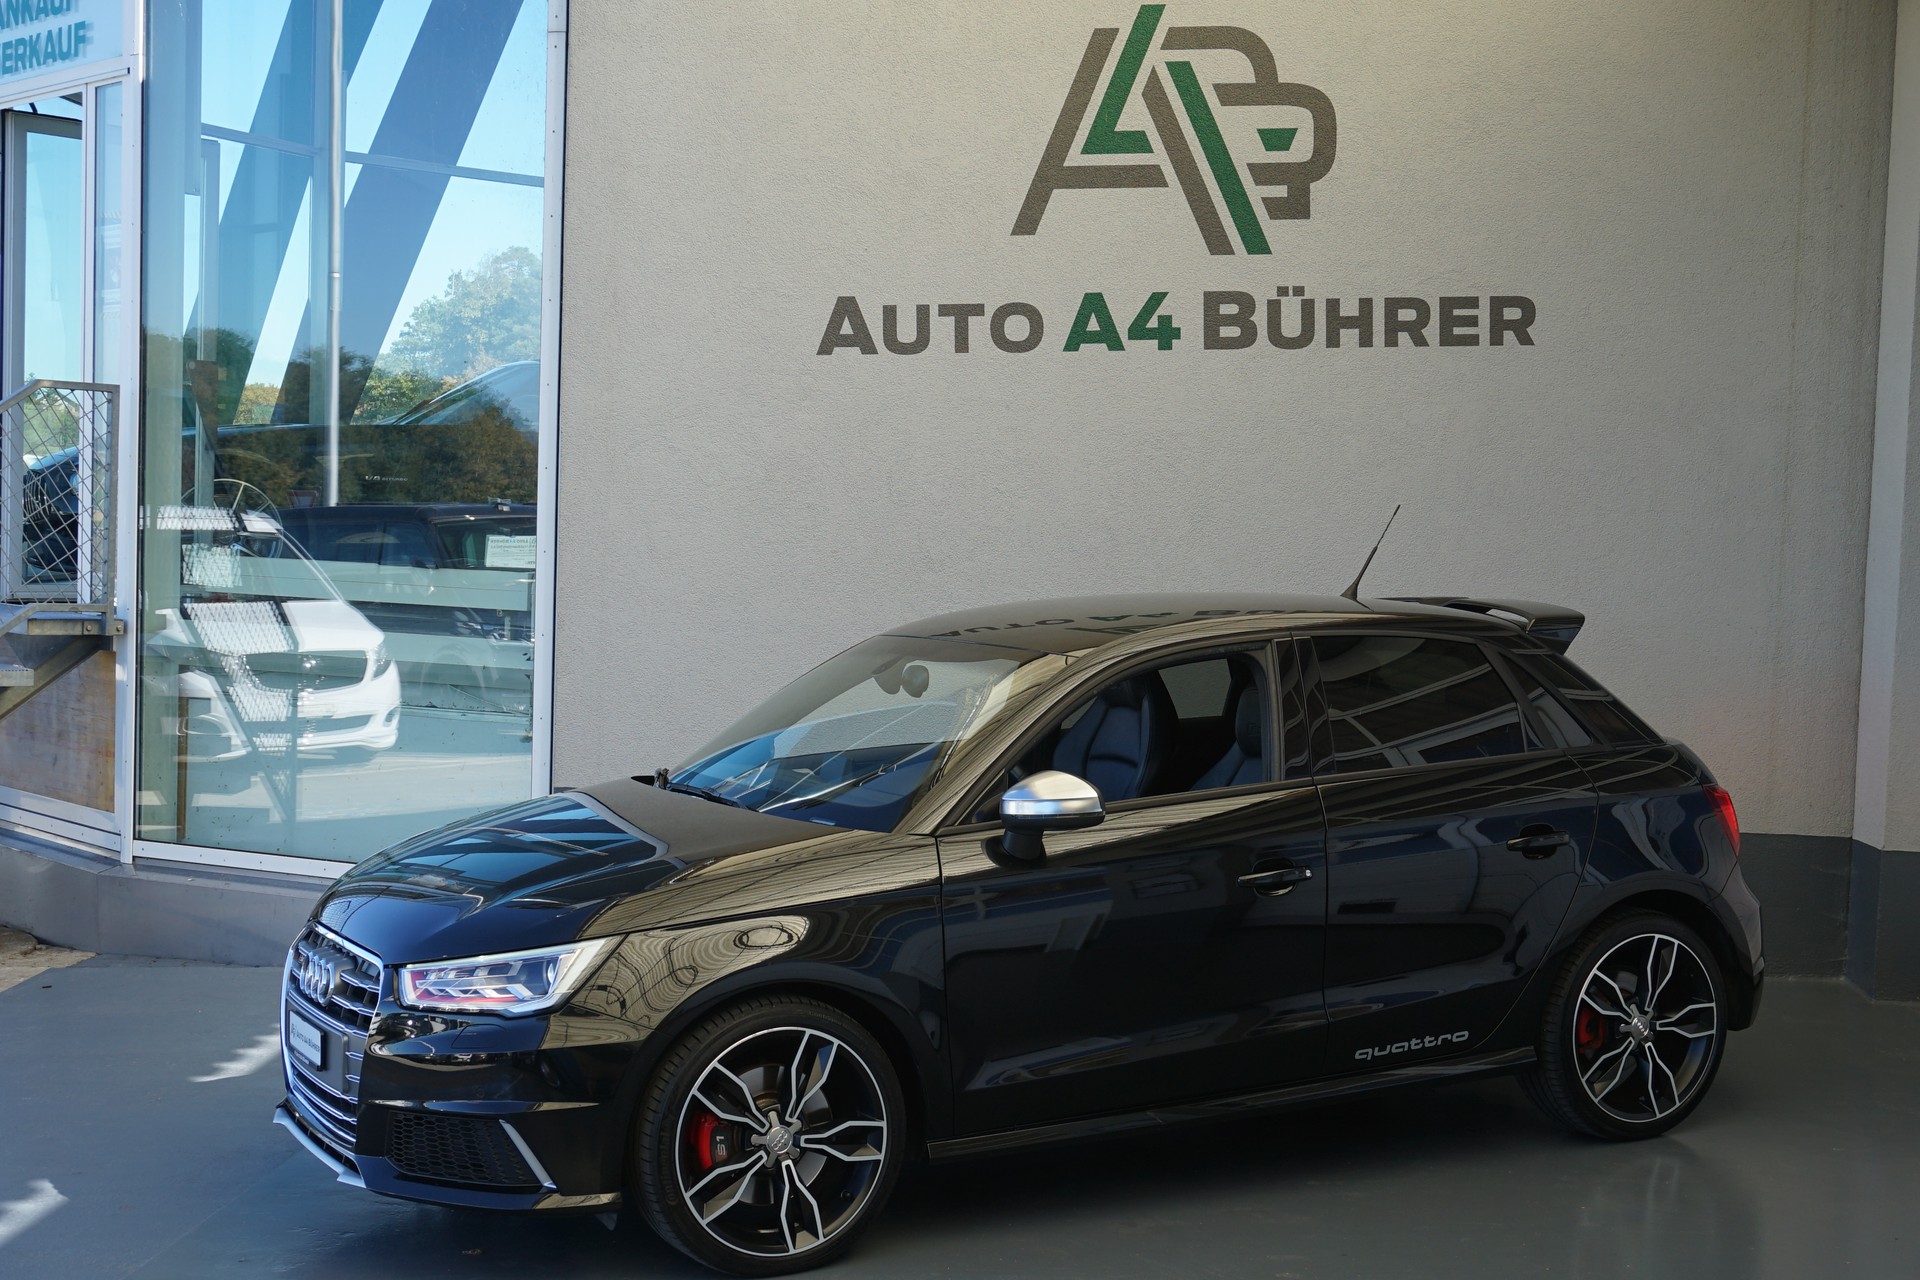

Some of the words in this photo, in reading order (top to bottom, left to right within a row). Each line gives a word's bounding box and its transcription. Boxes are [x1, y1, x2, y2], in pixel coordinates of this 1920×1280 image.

[0, 20, 86, 75] ERKAUF
[816, 296, 1044, 355] AUTO
[1063, 292, 1181, 352] A4
[1202, 286, 1537, 350] BÜHRER
[1354, 1030, 1469, 1060] quattro
[716, 1135, 726, 1156] S1
